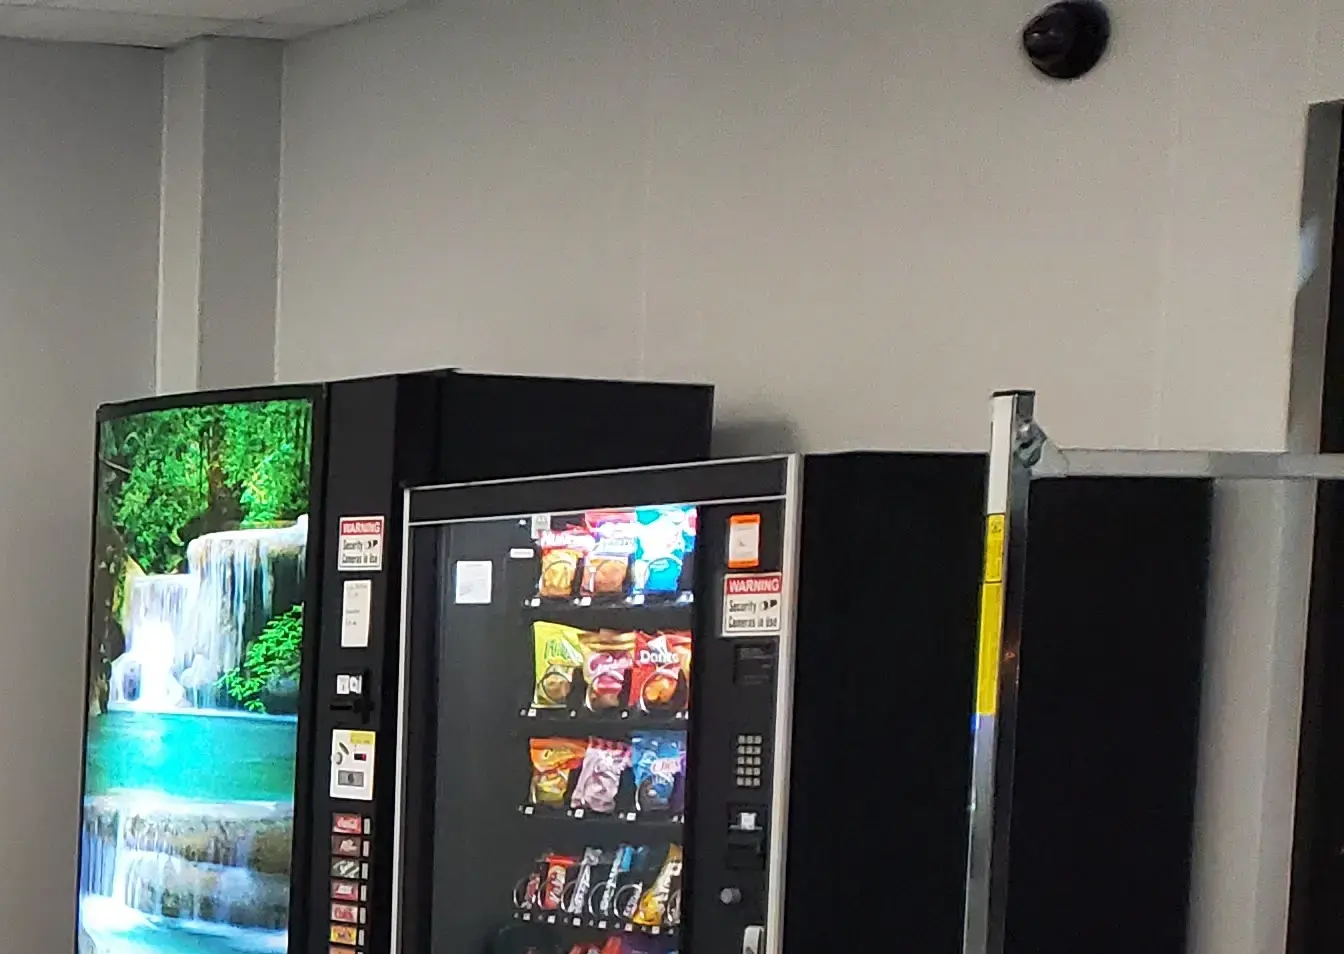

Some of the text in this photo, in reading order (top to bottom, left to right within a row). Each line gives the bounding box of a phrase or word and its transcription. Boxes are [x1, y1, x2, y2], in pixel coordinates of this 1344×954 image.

[343, 522, 380, 533] WARNING
[728, 578, 780, 593] WARNING
[729, 600, 757, 613] Security
[728, 616, 756, 628] Cameras
[757, 617, 764, 628] in
